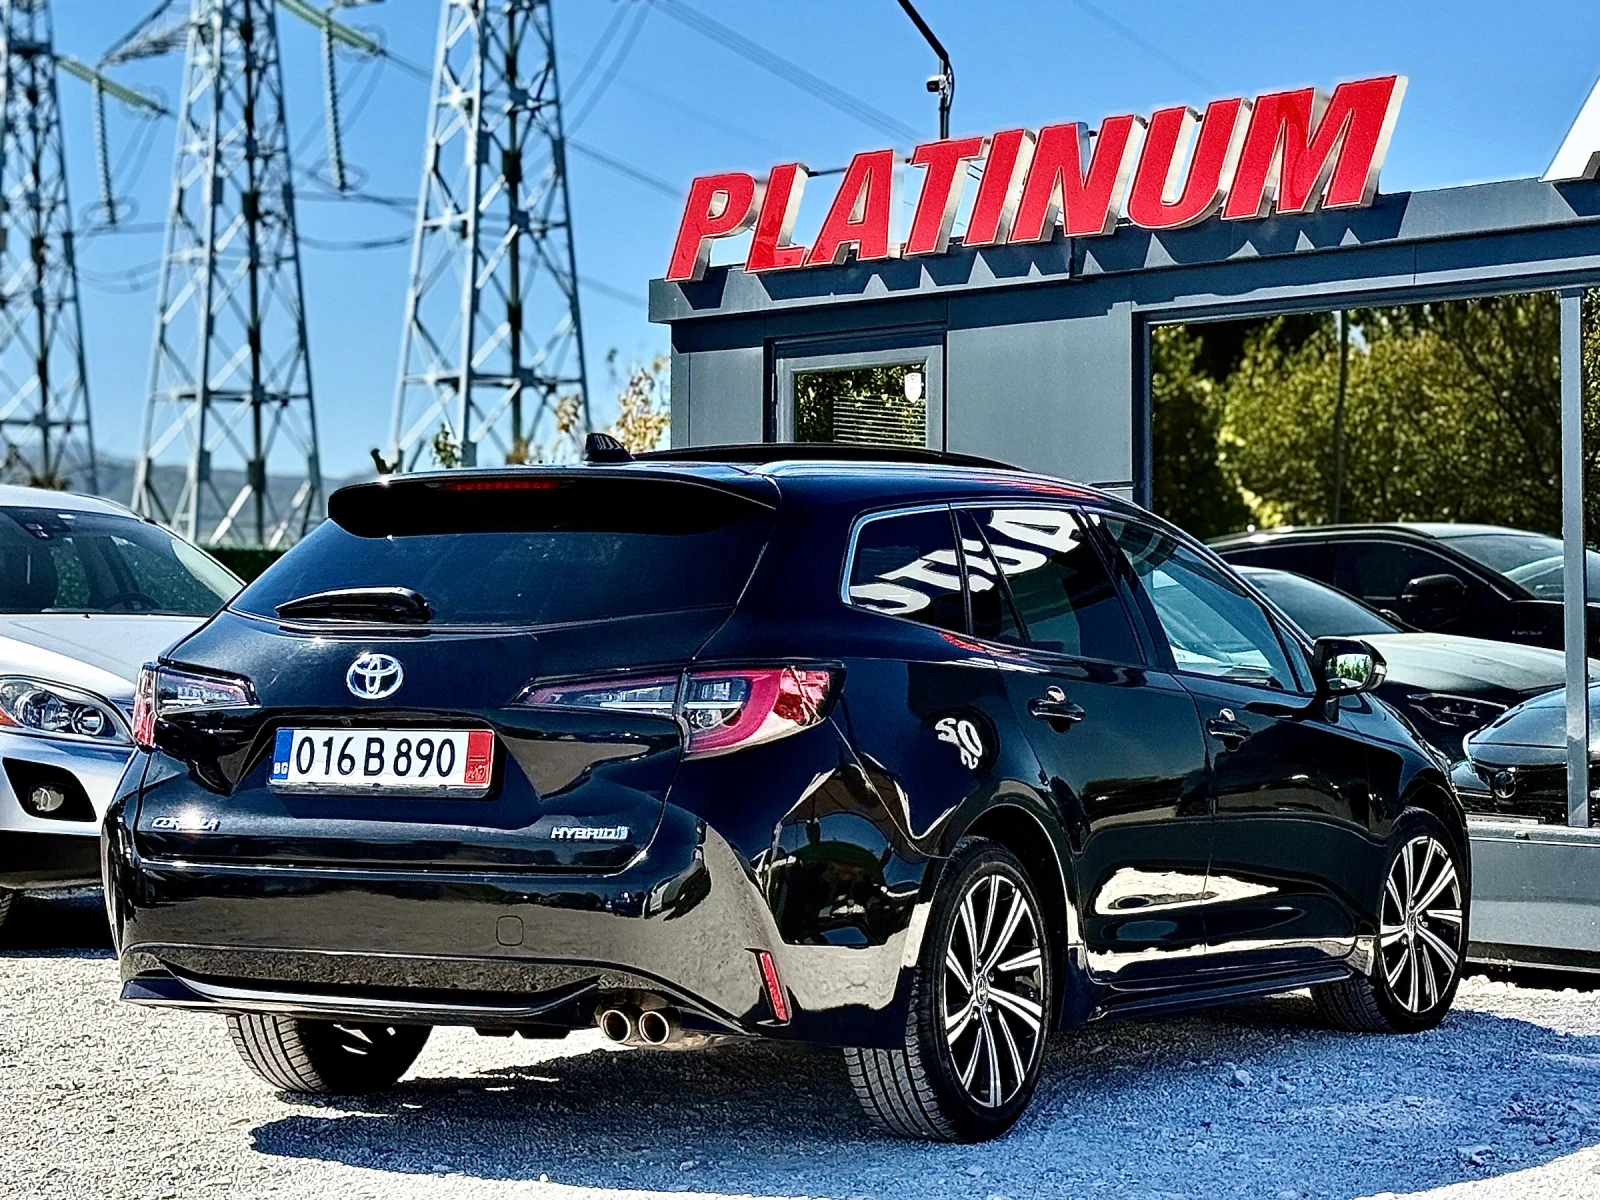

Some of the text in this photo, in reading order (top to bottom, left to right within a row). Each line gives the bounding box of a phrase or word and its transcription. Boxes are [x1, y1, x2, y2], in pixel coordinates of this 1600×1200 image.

[665, 75, 1408, 283] PLATINUM
[273, 762, 289, 775] BG
[550, 826, 618, 841] HYBRID
